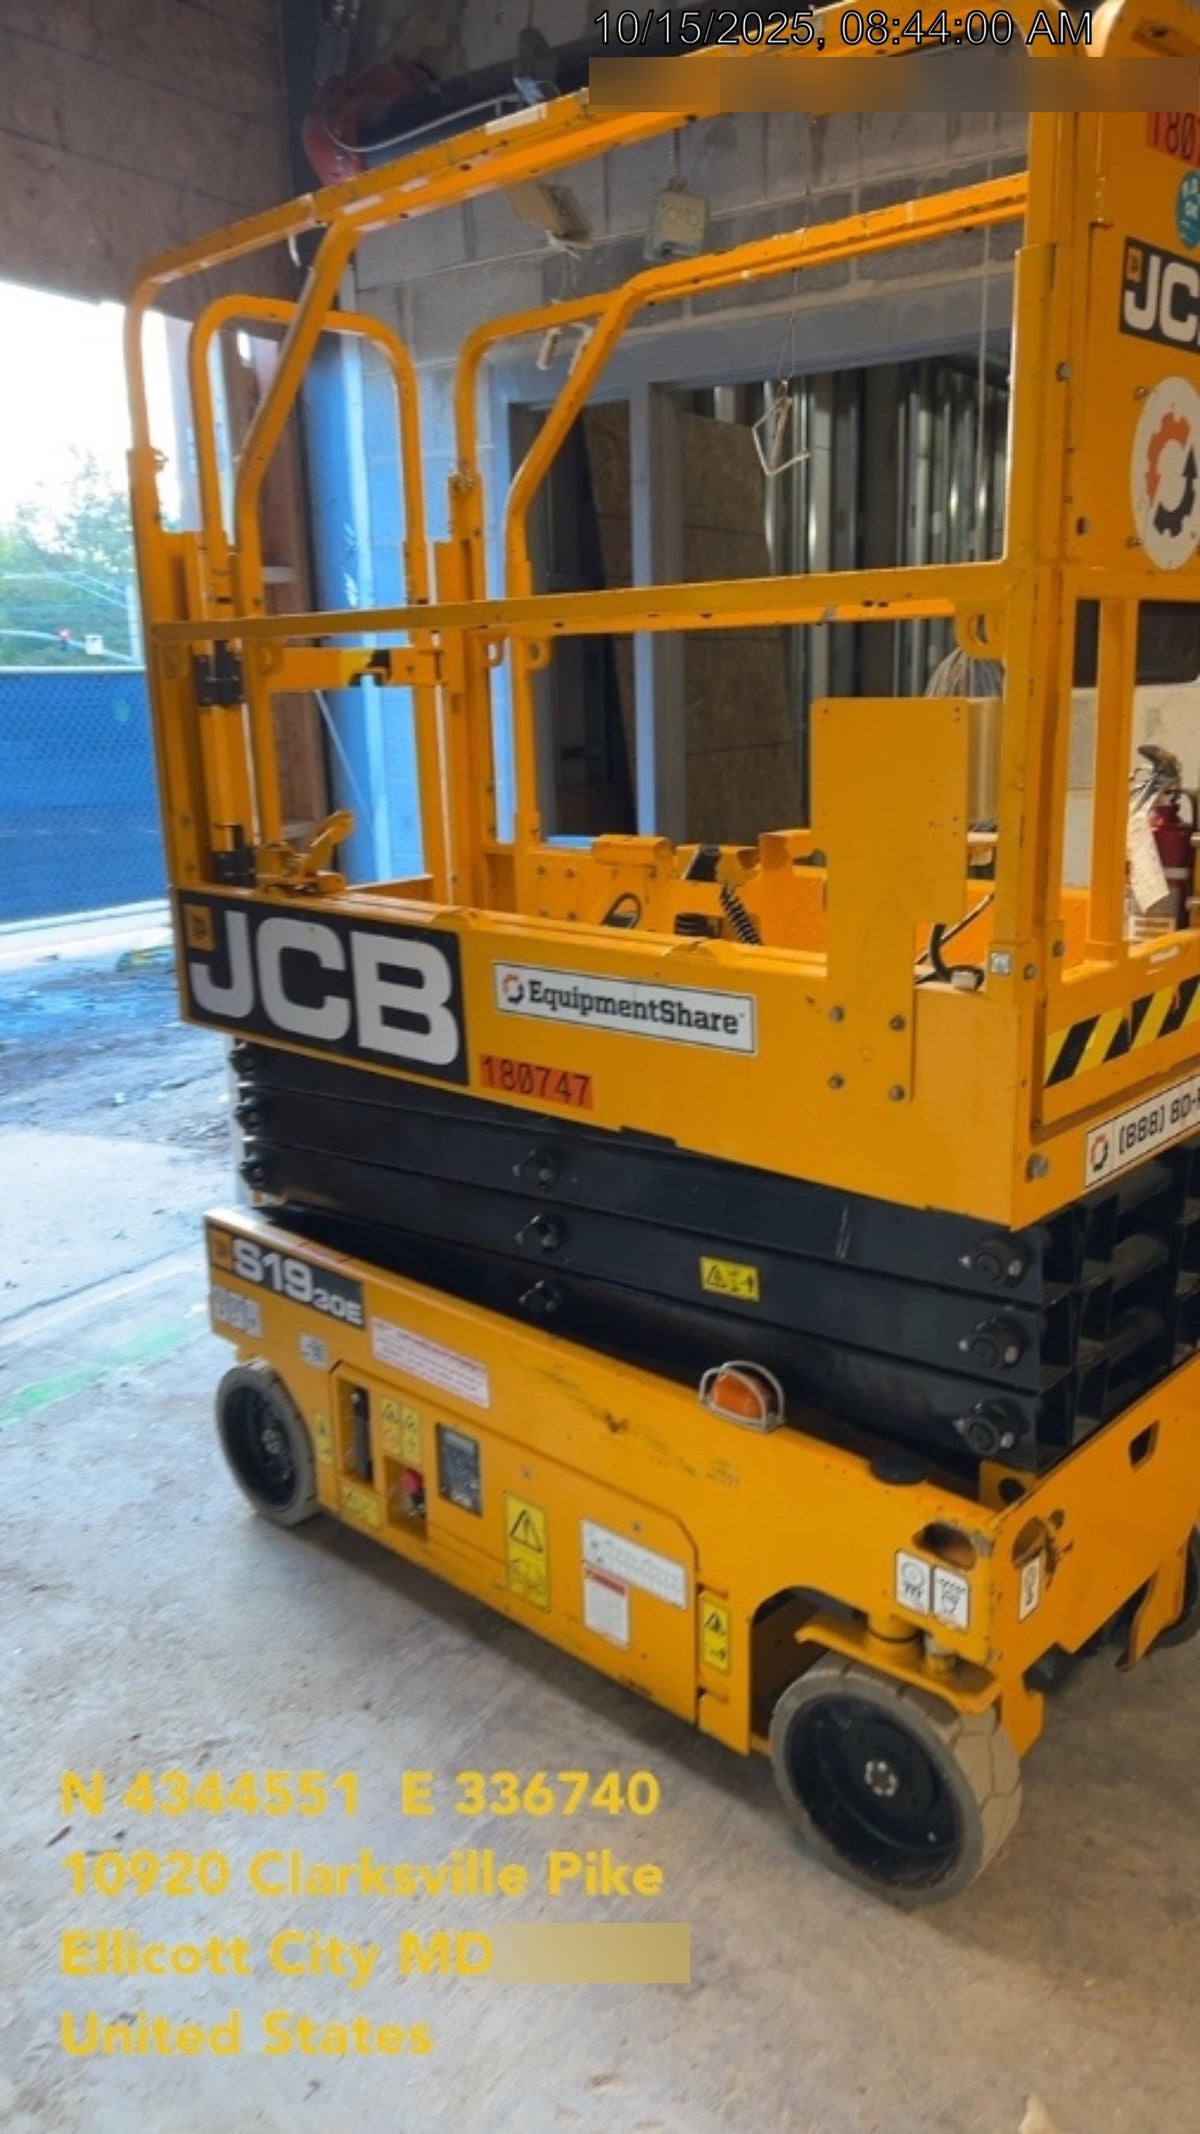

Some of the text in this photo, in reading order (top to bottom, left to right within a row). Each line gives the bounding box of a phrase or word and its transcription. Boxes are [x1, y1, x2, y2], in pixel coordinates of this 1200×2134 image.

[1154, 112, 1200, 161] 180
[1124, 253, 1200, 345] JC
[190, 910, 459, 1065] JCB
[528, 980, 739, 1035] EquipmentShare
[482, 1054, 593, 1108] 180747
[1171, 1087, 1200, 1124] 80-
